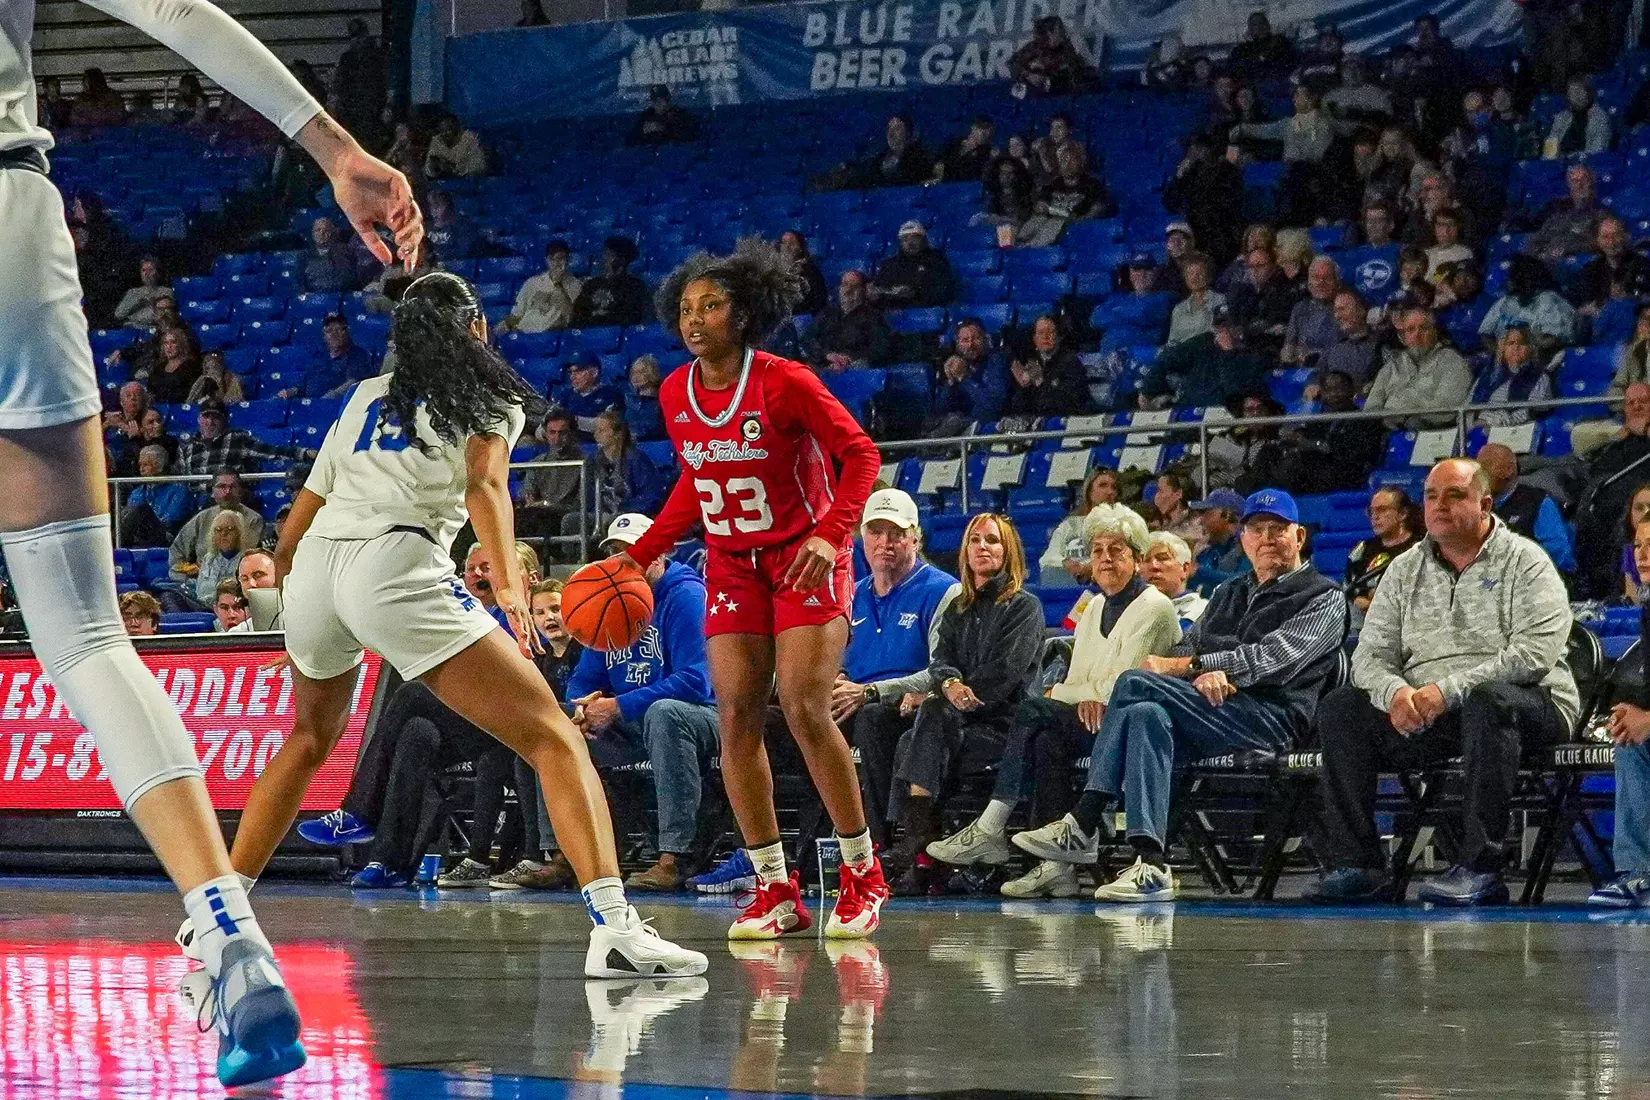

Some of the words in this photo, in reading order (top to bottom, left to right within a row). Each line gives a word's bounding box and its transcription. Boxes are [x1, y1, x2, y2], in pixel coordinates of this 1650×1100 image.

[802, 6, 914, 47] BLUE
[811, 48, 907, 91] BEER
[919, 30, 1104, 85] GARN
[680, 440, 705, 470] Lady
[703, 439, 768, 462] Techsters
[694, 476, 774, 536] 23
[1288, 754, 1314, 768] BLUE
[1555, 749, 1581, 765] BLUE
[1584, 747, 1616, 764] RAIDE
